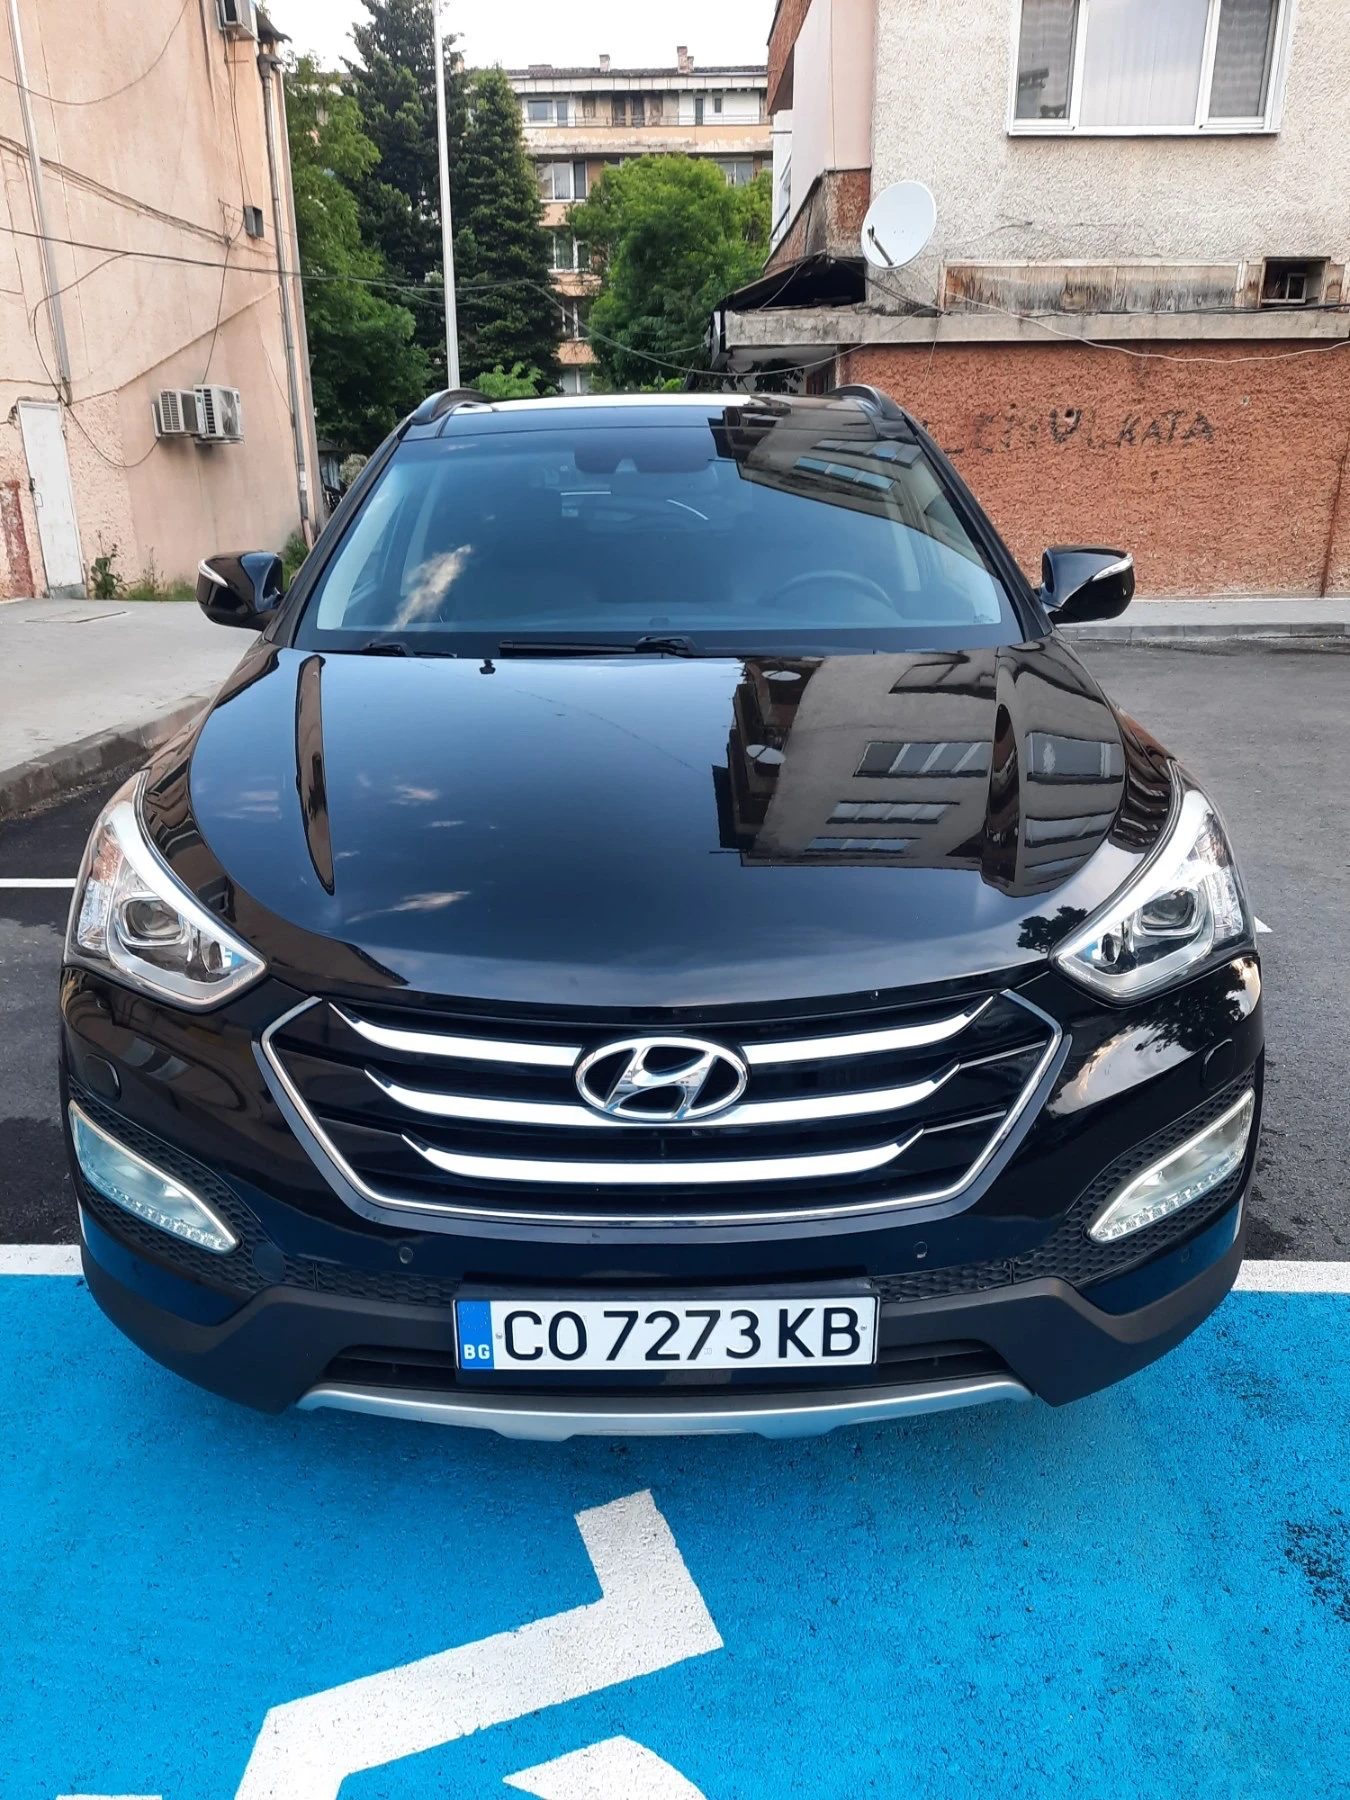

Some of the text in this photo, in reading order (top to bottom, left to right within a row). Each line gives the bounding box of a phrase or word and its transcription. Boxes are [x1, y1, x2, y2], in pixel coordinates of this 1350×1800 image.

[603, 1310, 762, 1360] 7273
[778, 1307, 861, 1359] KB
[463, 1344, 490, 1360] BG
